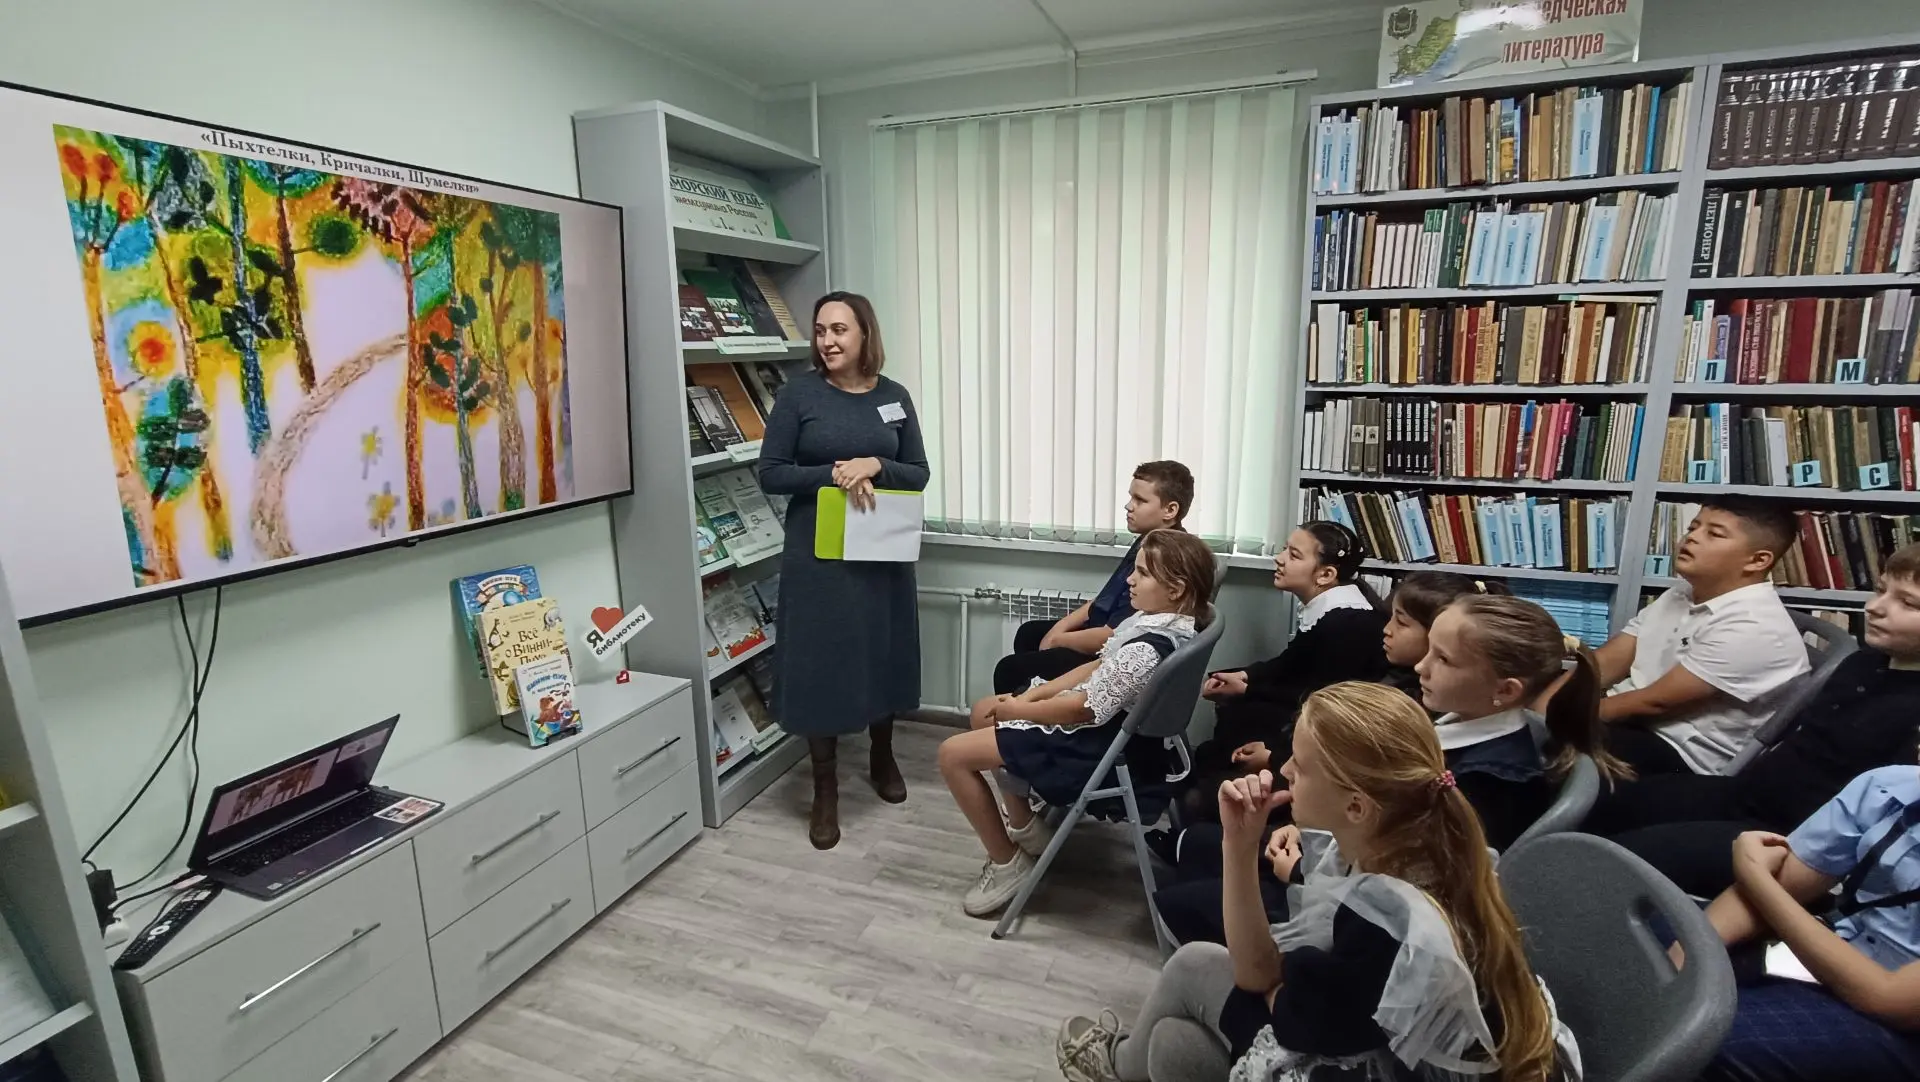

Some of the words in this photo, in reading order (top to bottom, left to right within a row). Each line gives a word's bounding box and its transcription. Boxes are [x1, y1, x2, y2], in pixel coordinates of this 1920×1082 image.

[1502, 32, 1605, 63] литература
[201, 130, 316, 166] «Пыхтелки,
[320, 151, 405, 185] Кричалки,
[408, 169, 480, 195] Шумелки»
[727, 204, 758, 219] России
[1700, 201, 1718, 260] ЛЕГИОНЕР
[1704, 361, 1717, 381] Л
[1840, 361, 1861, 381] М
[1694, 463, 1707, 481] П
[1801, 463, 1814, 483] Р
[1869, 466, 1882, 486] С
[1653, 557, 1664, 574] Т
[518, 627, 539, 643] Всё
[586, 629, 604, 649] Я
[595, 612, 646, 656] библиотеку
[505, 649, 512, 658] о
